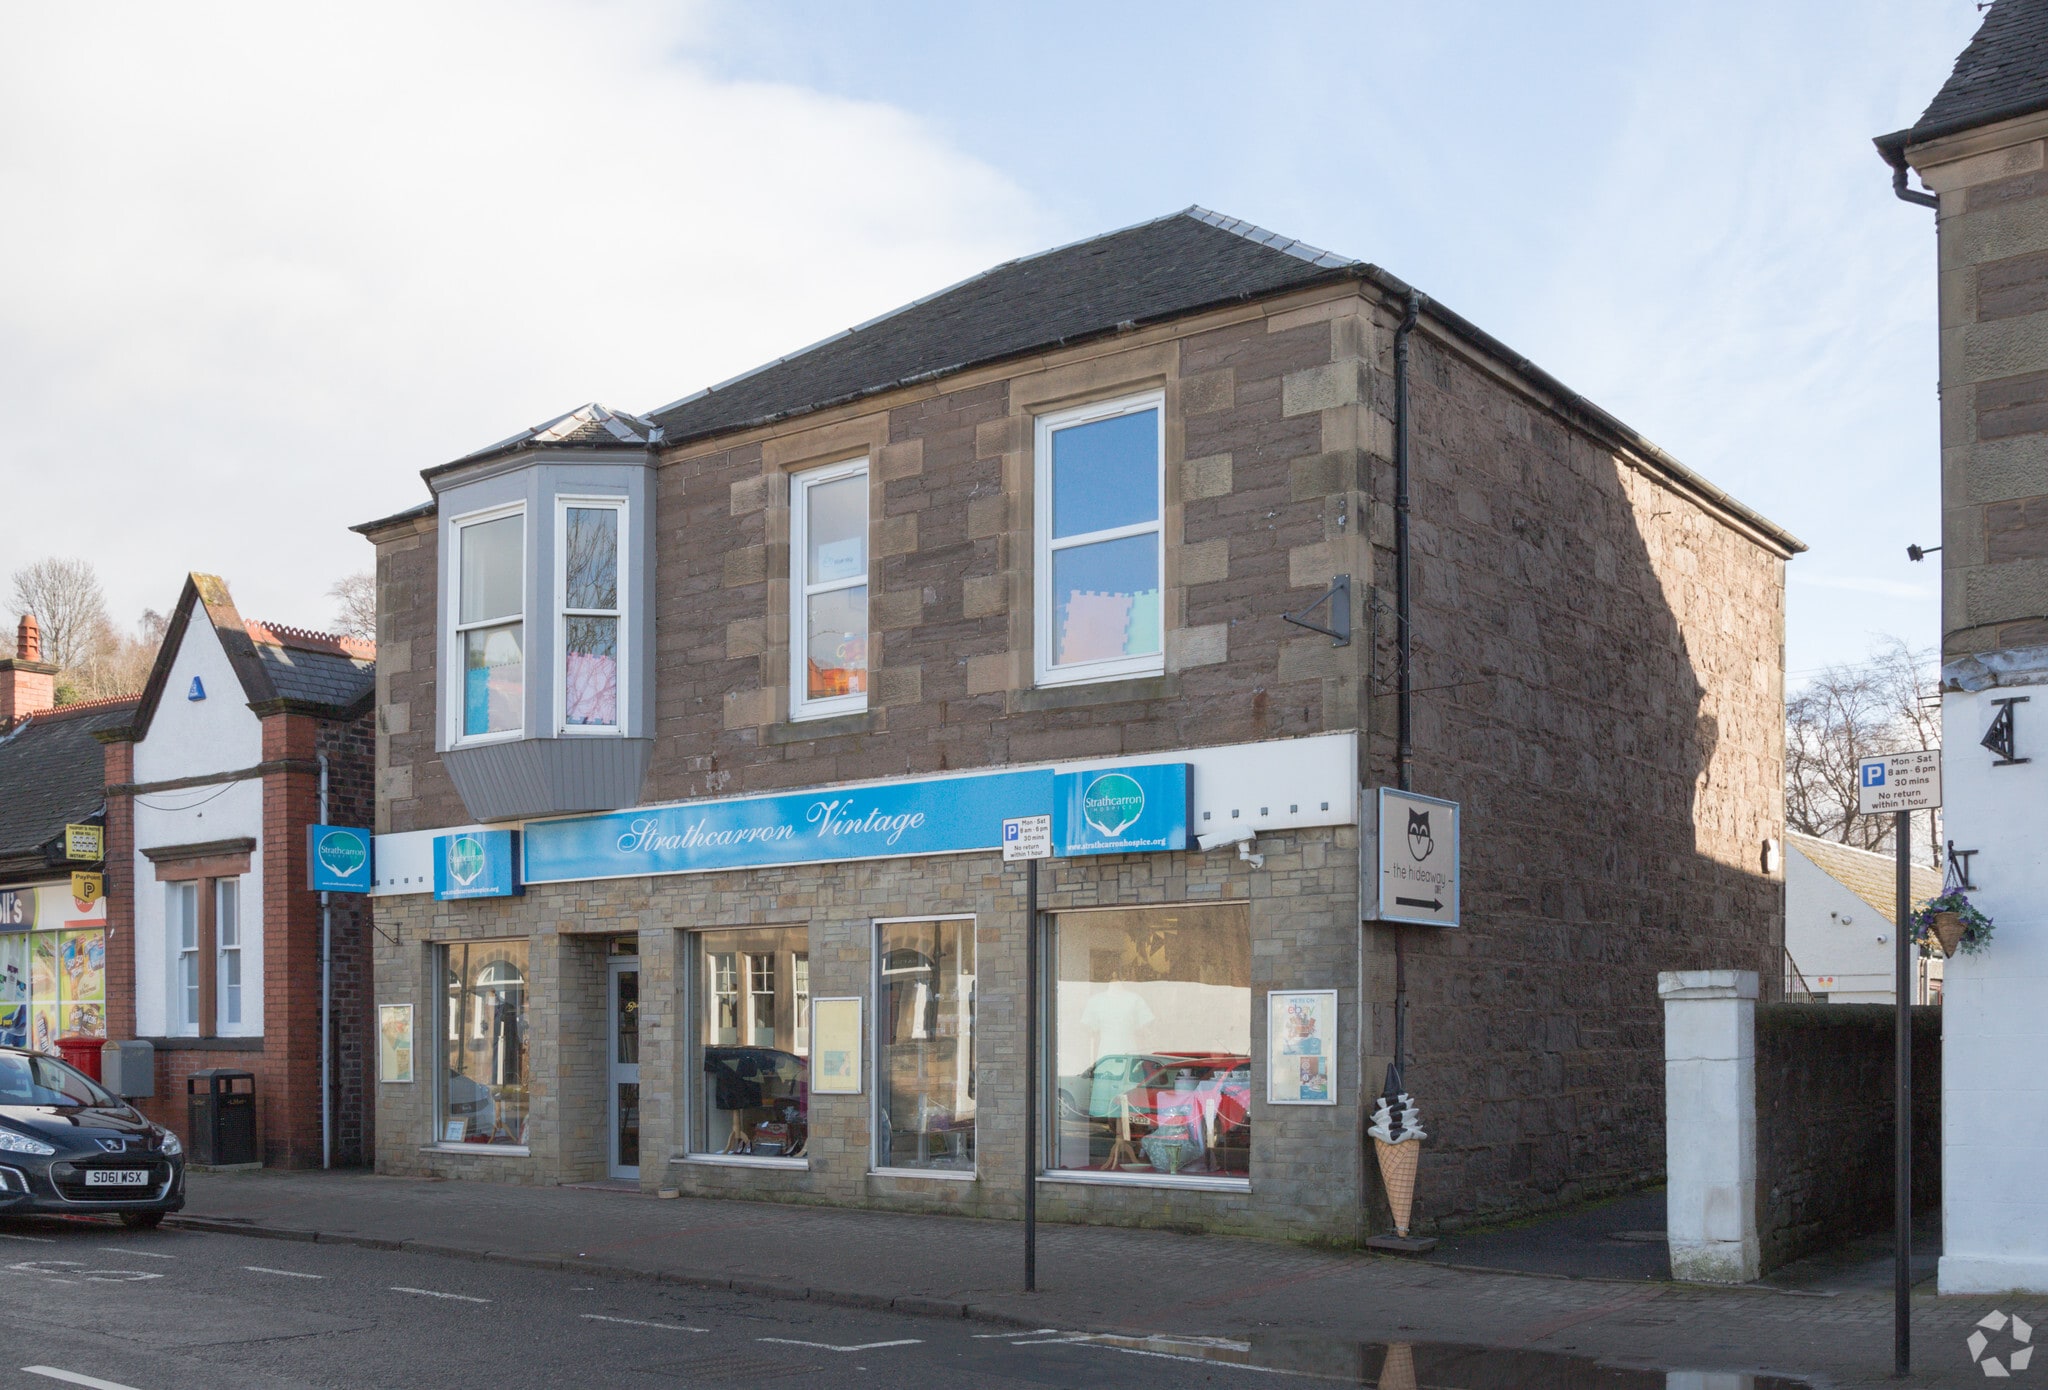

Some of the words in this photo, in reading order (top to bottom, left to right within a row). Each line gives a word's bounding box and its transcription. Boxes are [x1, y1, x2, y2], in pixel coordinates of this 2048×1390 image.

[1917, 755, 1932, 763] Sat
[1868, 766, 1882, 784] P
[1909, 777, 1930, 785] mins
[1894, 790, 1921, 798] return
[1085, 795, 1142, 808] Strathcarron
[1872, 801, 1898, 809] within
[616, 818, 796, 853] Strathcarron
[806, 799, 926, 846] Vintage
[1008, 825, 1017, 839] P
[1067, 838, 1167, 850] www.strathcarronhospice.org
[320, 845, 365, 856] Strathcarron
[1393, 862, 1406, 880] the
[1409, 865, 1446, 888] hideaway
[0, 892, 22, 924] ll's
[93, 1172, 118, 1182] SD61
[121, 1172, 142, 1182] WSX
